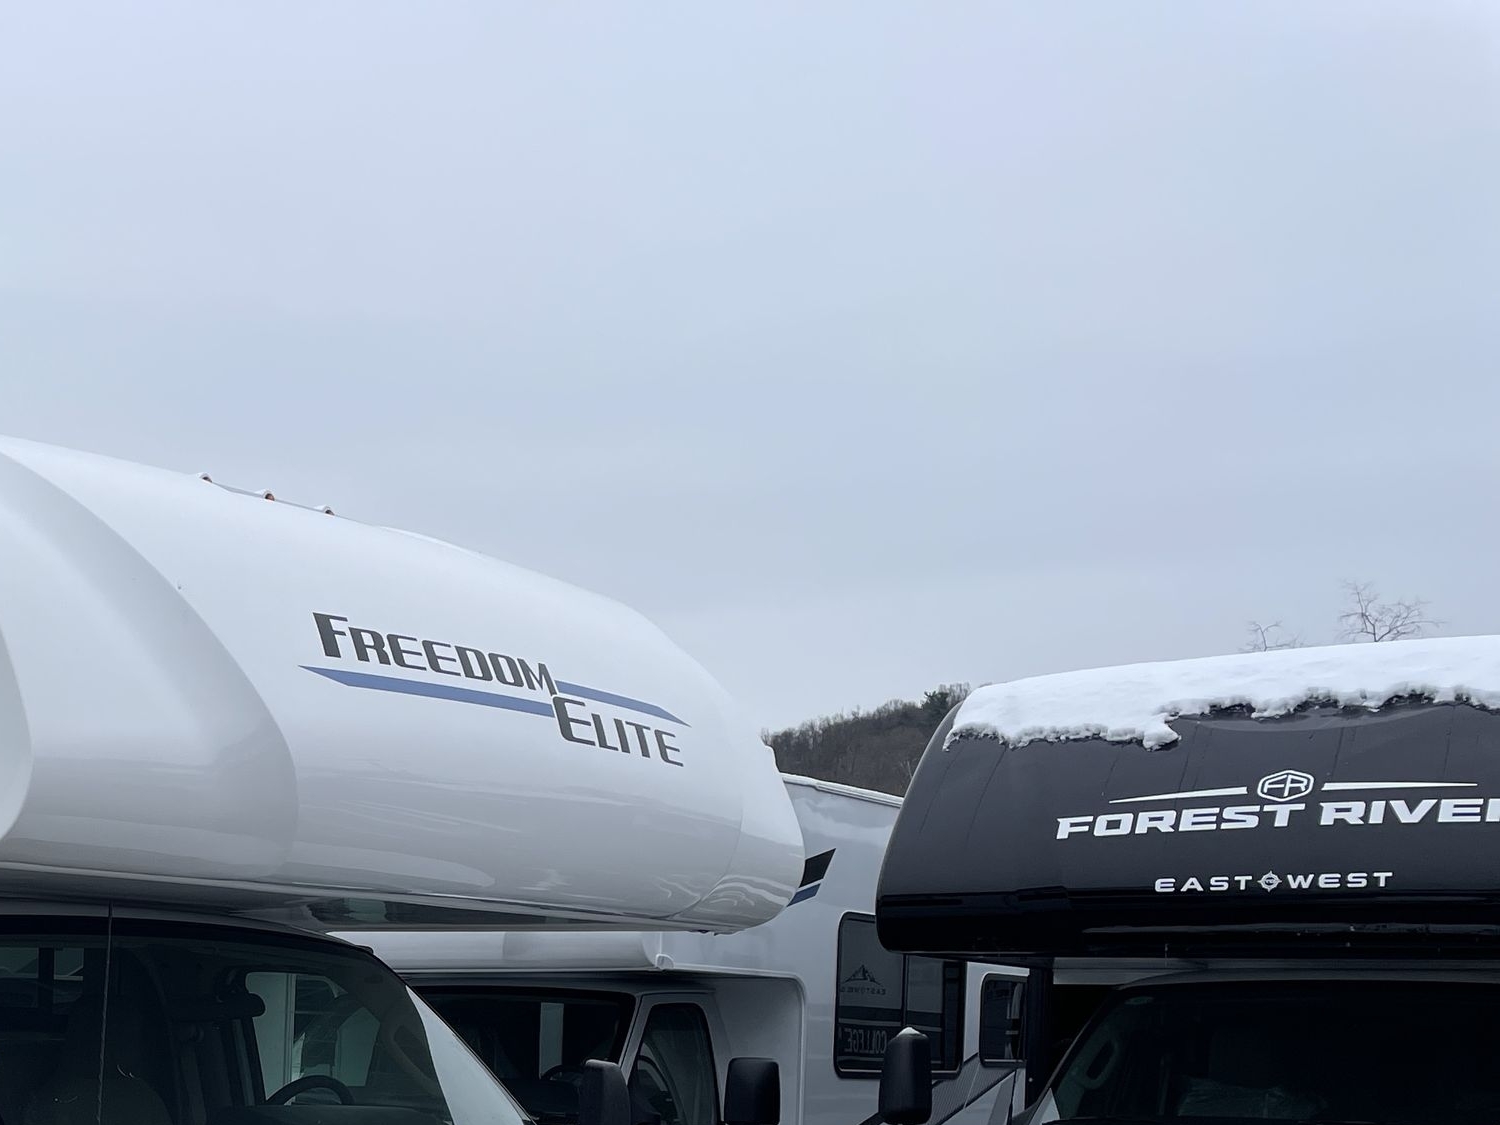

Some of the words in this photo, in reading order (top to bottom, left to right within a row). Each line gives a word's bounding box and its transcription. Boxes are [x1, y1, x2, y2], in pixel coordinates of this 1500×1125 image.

[312, 612, 558, 696] FREEDOM
[552, 696, 684, 768] ELITE
[1055, 803, 1306, 839] FOREST
[1154, 875, 1253, 893] EAST
[1286, 871, 1394, 889] WEST
